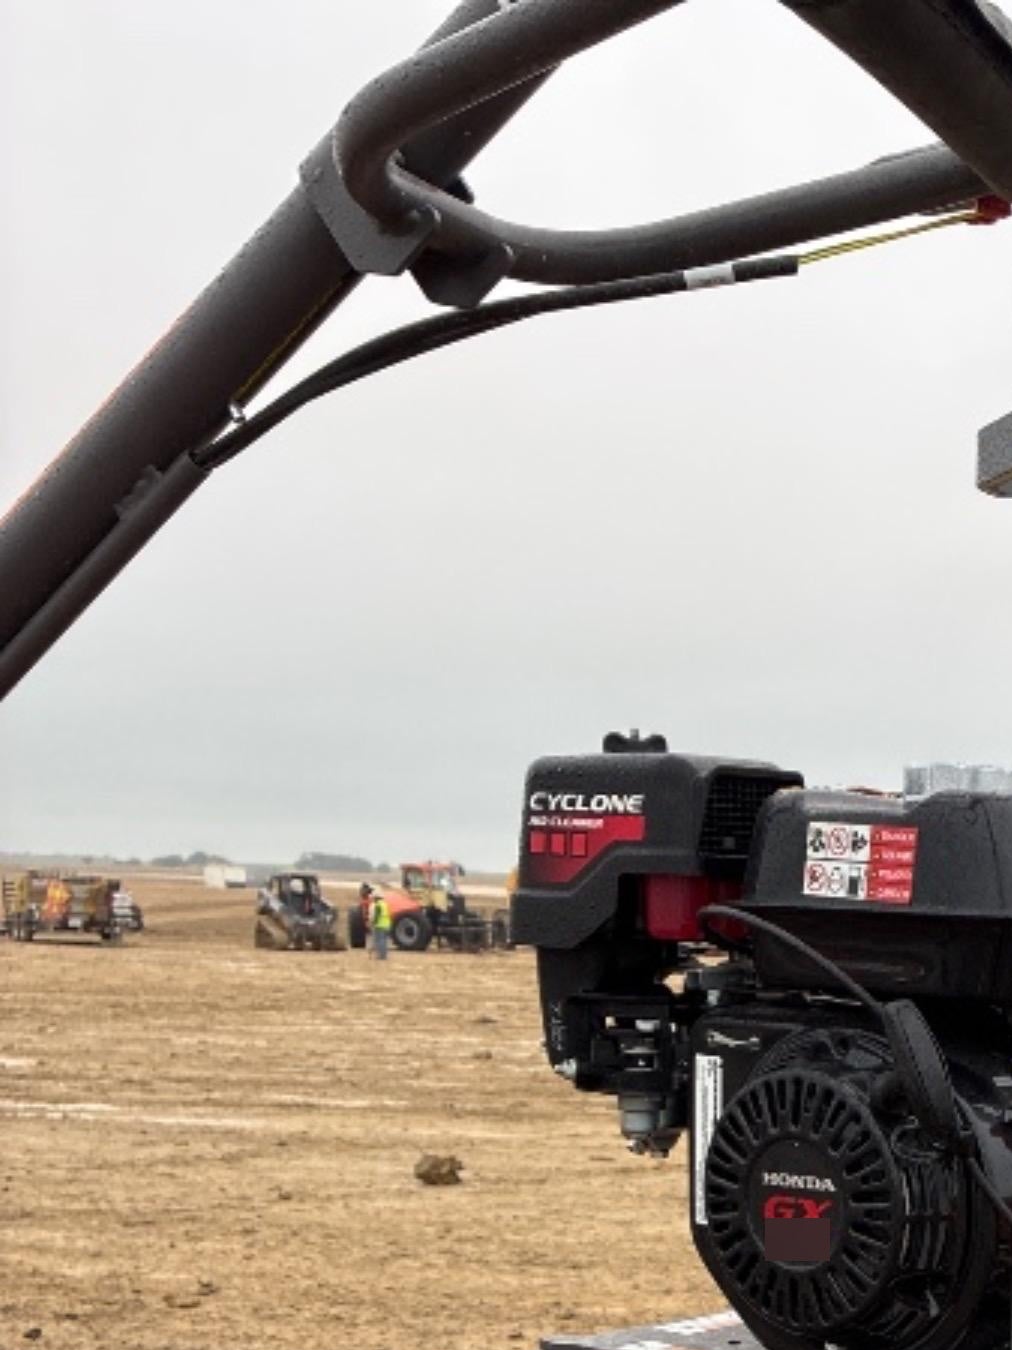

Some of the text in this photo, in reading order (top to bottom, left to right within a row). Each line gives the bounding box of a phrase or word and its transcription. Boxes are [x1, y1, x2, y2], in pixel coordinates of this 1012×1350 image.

[529, 791, 644, 813] CYCLONE
[762, 1172, 836, 1192] HONDA
[764, 1194, 833, 1218] GX
